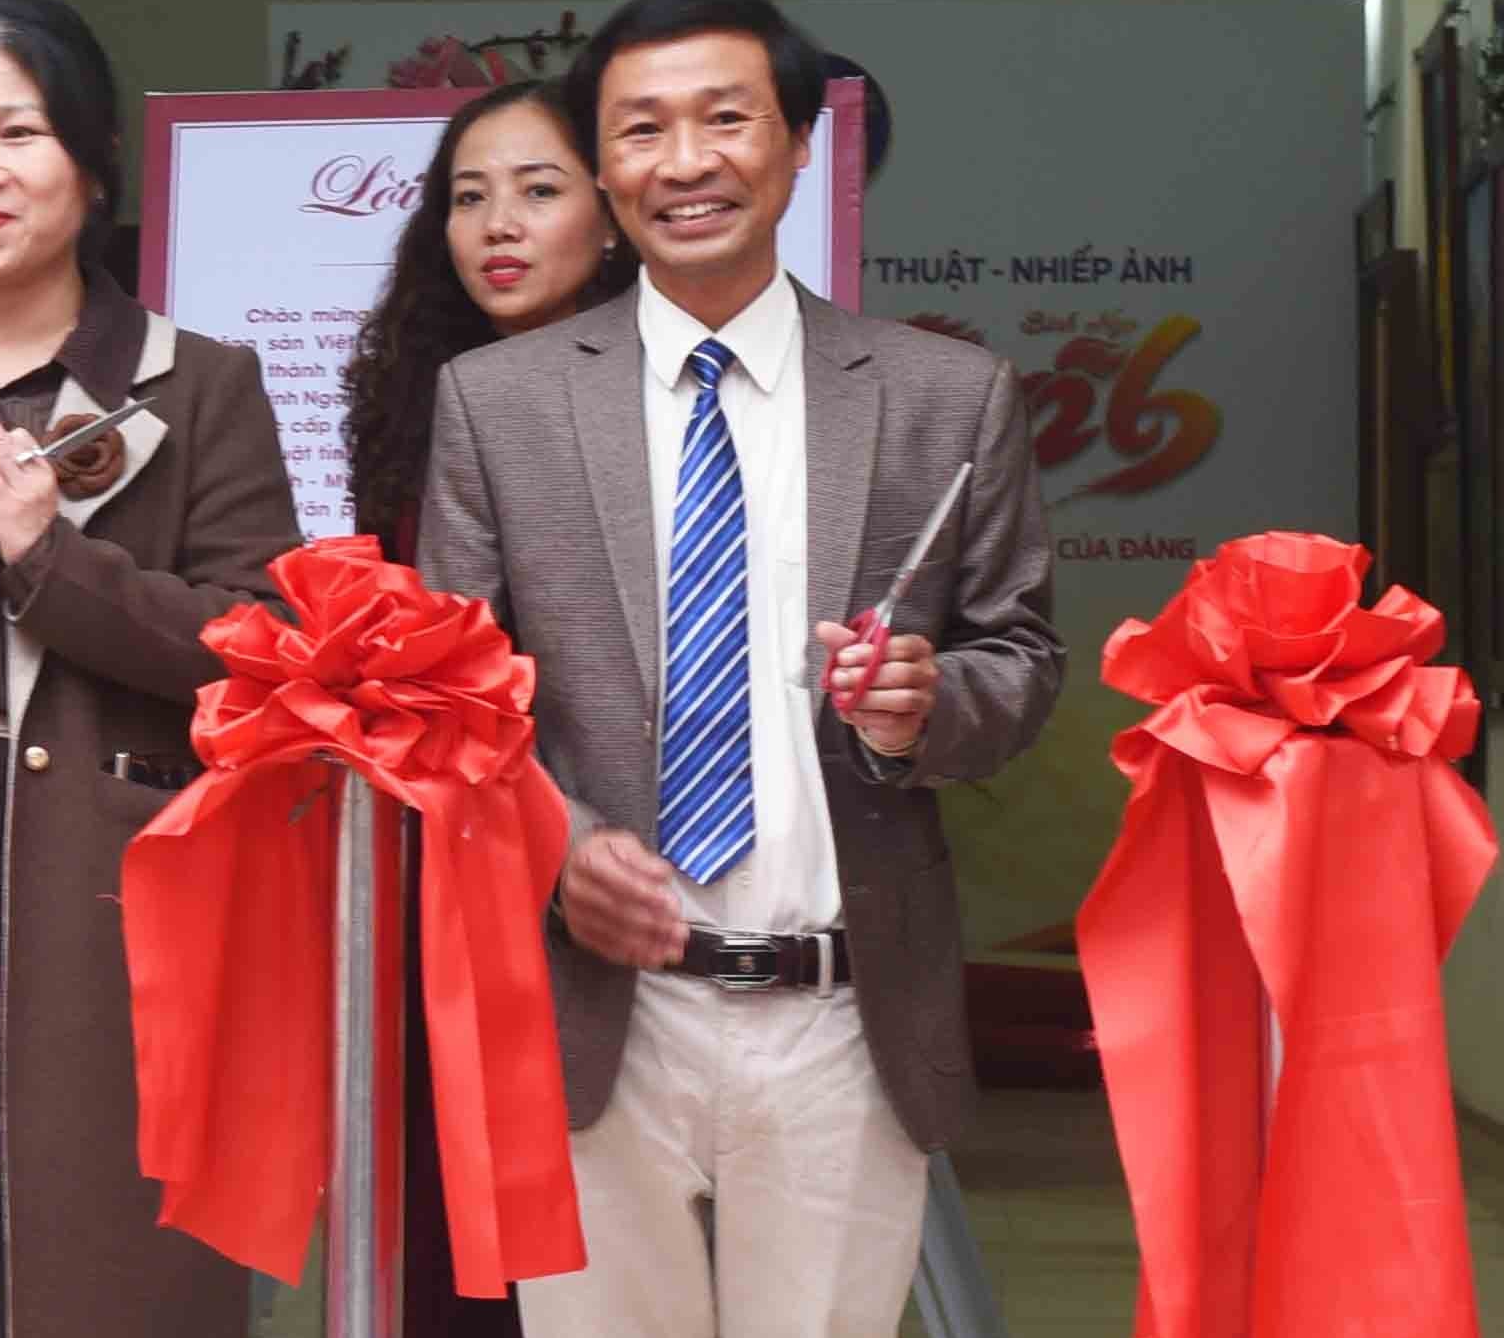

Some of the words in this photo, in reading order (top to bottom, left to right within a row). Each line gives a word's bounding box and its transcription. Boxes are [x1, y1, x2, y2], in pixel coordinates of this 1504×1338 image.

[297, 154, 424, 217] Lời
[876, 249, 985, 293] THUẬT
[1010, 243, 1113, 285] NHIẾP
[1119, 247, 1193, 285] ẢNH
[246, 306, 303, 324] Chào
[267, 333, 305, 350] sản
[290, 414, 332, 436] cấp
